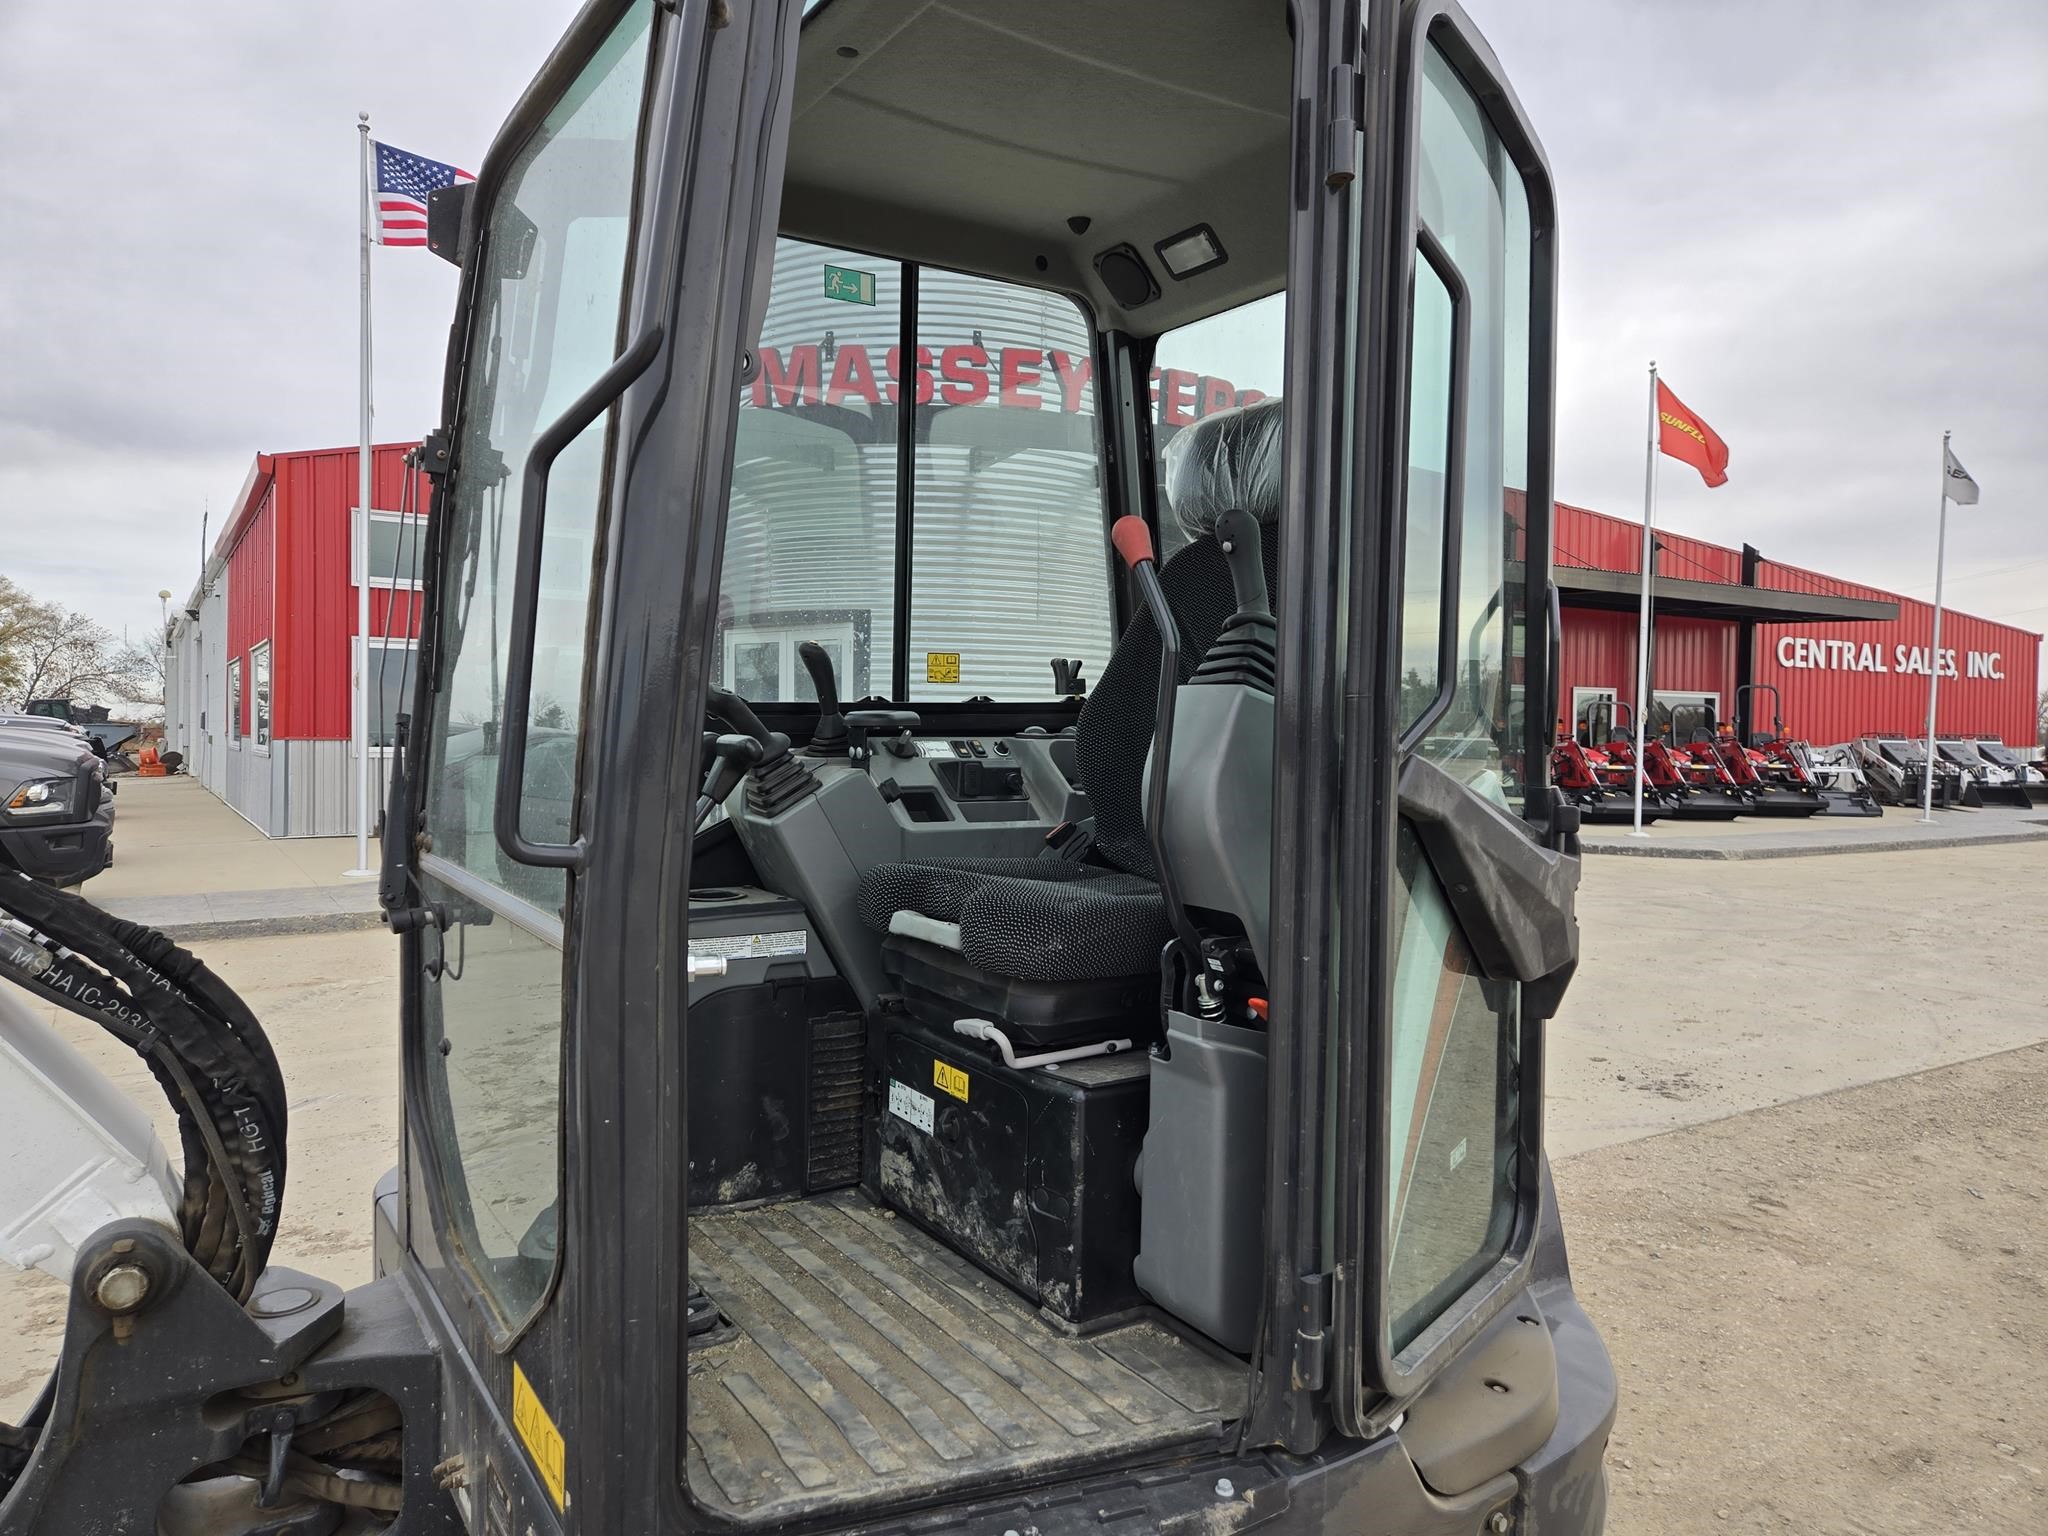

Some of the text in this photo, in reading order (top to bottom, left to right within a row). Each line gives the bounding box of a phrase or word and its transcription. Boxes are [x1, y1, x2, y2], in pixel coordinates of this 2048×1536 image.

[751, 344, 1092, 413] MASSEY
[1776, 636, 2005, 681] CENTRAL SALES, INC.
[9, 946, 73, 992] MSHA
